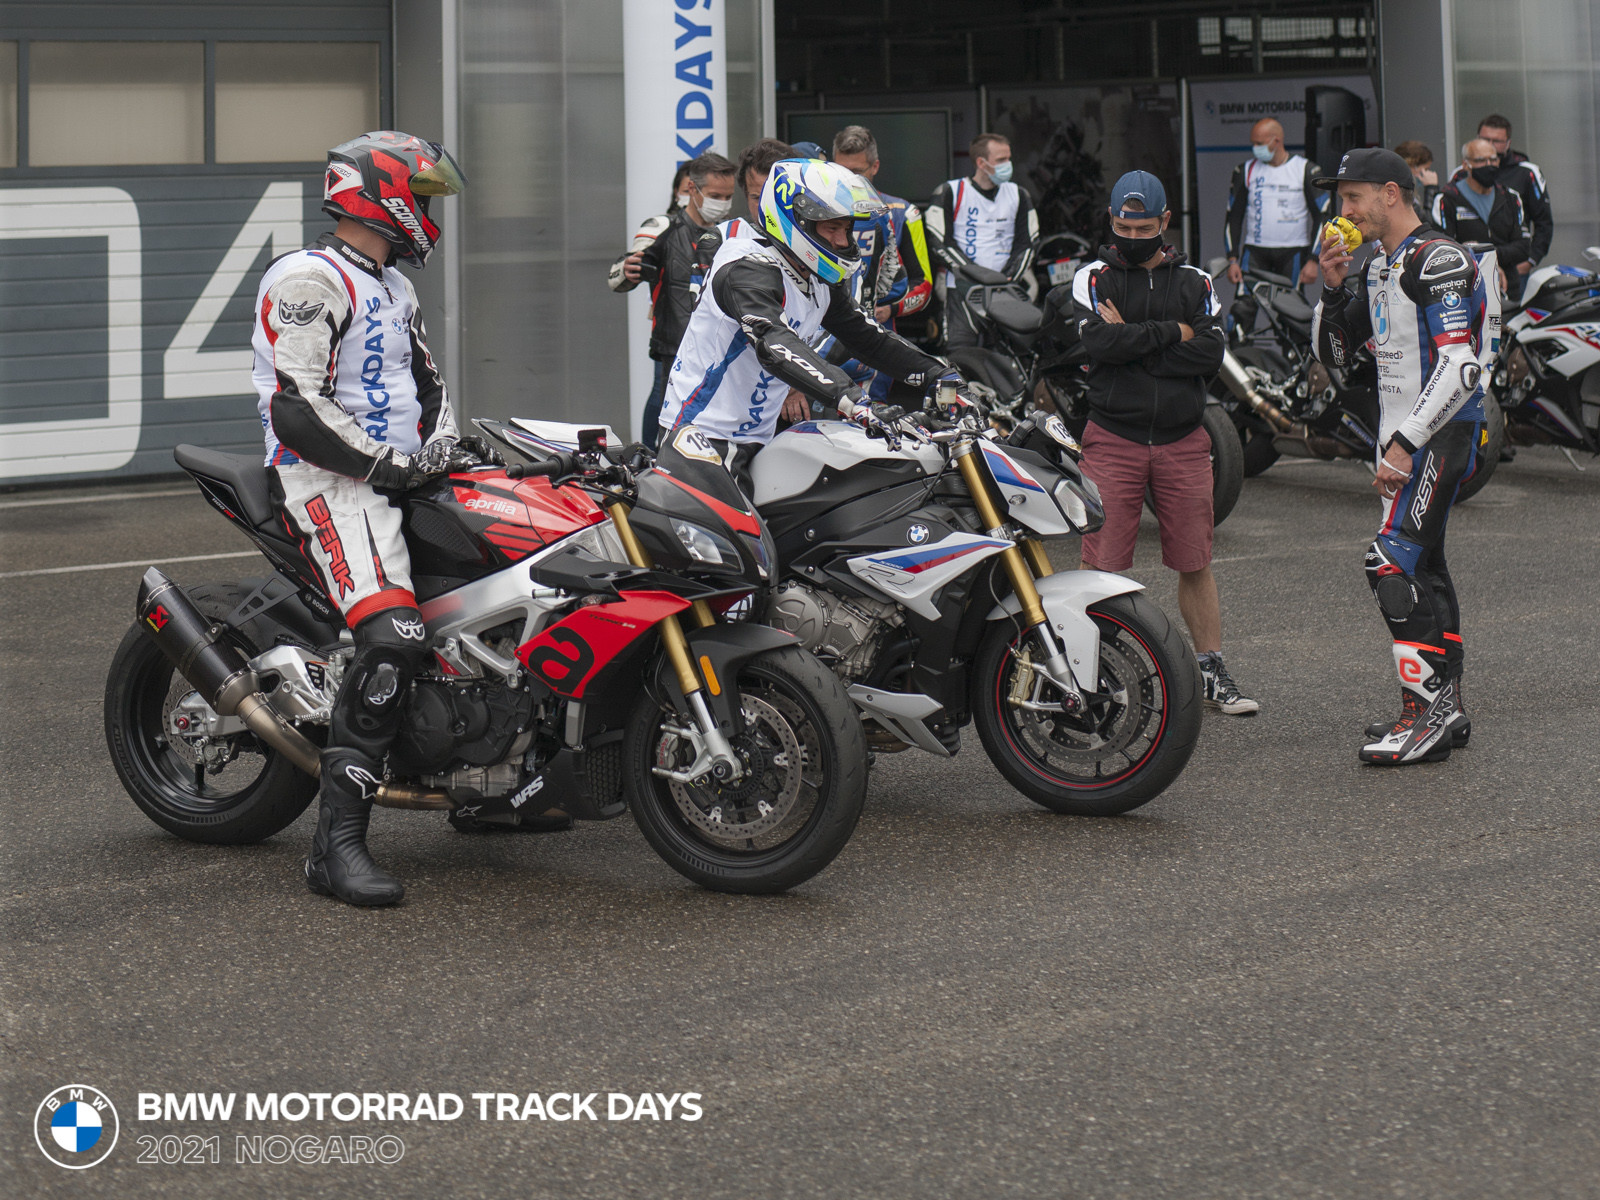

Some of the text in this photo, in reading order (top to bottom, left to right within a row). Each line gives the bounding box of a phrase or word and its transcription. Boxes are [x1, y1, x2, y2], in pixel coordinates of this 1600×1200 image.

[1219, 102, 1245, 115] BMW
[341, 244, 376, 271] BERIK
[769, 343, 834, 386] IXON
[1412, 398, 1427, 417] BMW
[1426, 355, 1450, 398] MOTORRAD
[465, 498, 517, 515] aprilia
[1410, 449, 1438, 531] RST
[304, 493, 355, 601] BERIK
[510, 775, 544, 809] WRS
